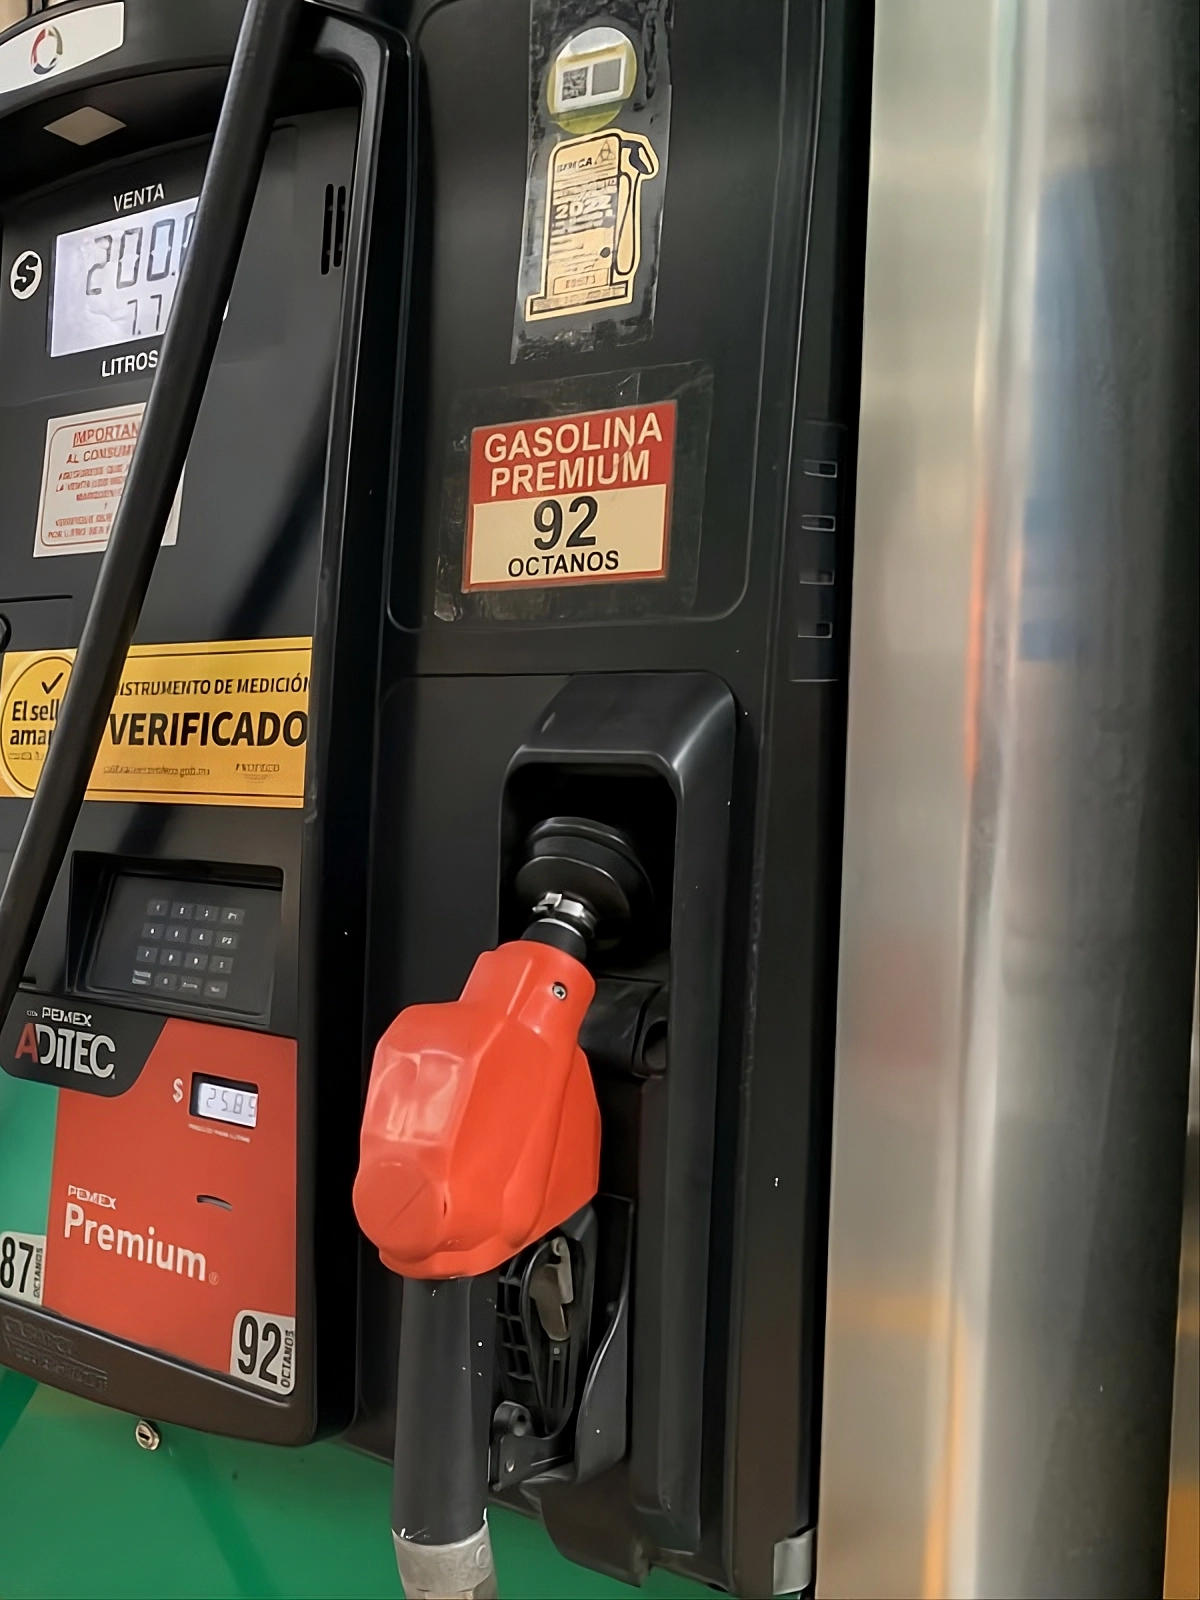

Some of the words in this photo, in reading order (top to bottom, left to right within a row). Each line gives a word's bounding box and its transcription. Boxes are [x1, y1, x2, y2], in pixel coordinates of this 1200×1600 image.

[113, 183, 165, 212] VENTA
[101, 350, 158, 378] LITROS
[484, 412, 663, 463] GASOLINA
[491, 450, 650, 497] PREMIUM
[533, 495, 598, 551] 92
[507, 550, 619, 578] OCTANOS
[11, 699, 28, 722] El
[29, 698, 60, 722] sell
[214, 678, 234, 695] DE
[109, 710, 308, 748] VERIFICADO
[0, 1236, 35, 1294] 87
[63, 1202, 207, 1282] Premium
[237, 1315, 282, 1385] 92
[280, 1329, 295, 1389] OCTANOS
